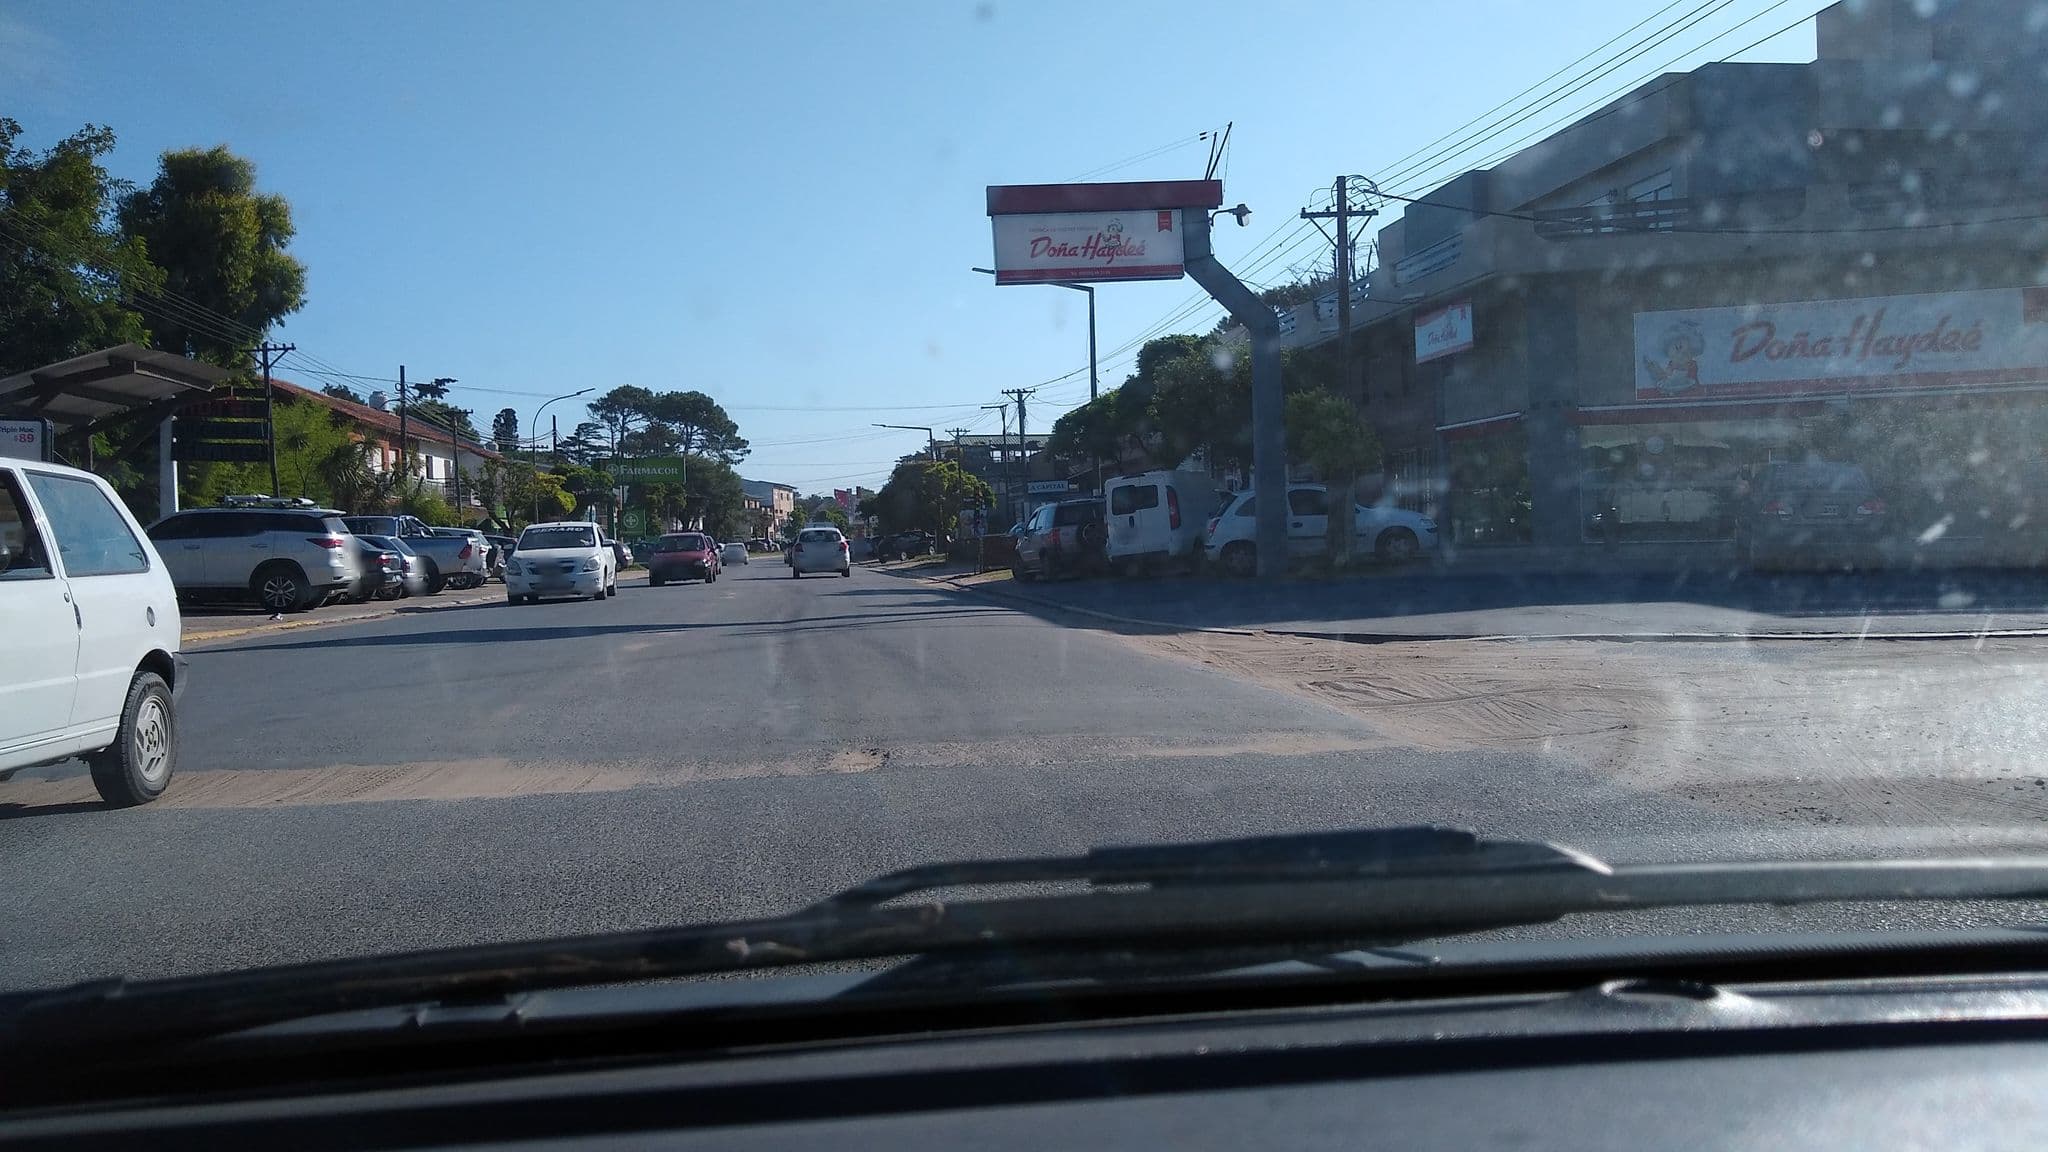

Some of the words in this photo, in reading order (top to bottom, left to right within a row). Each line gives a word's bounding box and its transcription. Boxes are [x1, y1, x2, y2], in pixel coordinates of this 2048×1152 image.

[1030, 236, 1079, 259] Doña
[1081, 232, 1147, 265] Haydeé
[1729, 320, 1832, 363] Doña
[620, 464, 678, 476] FARMACOR
